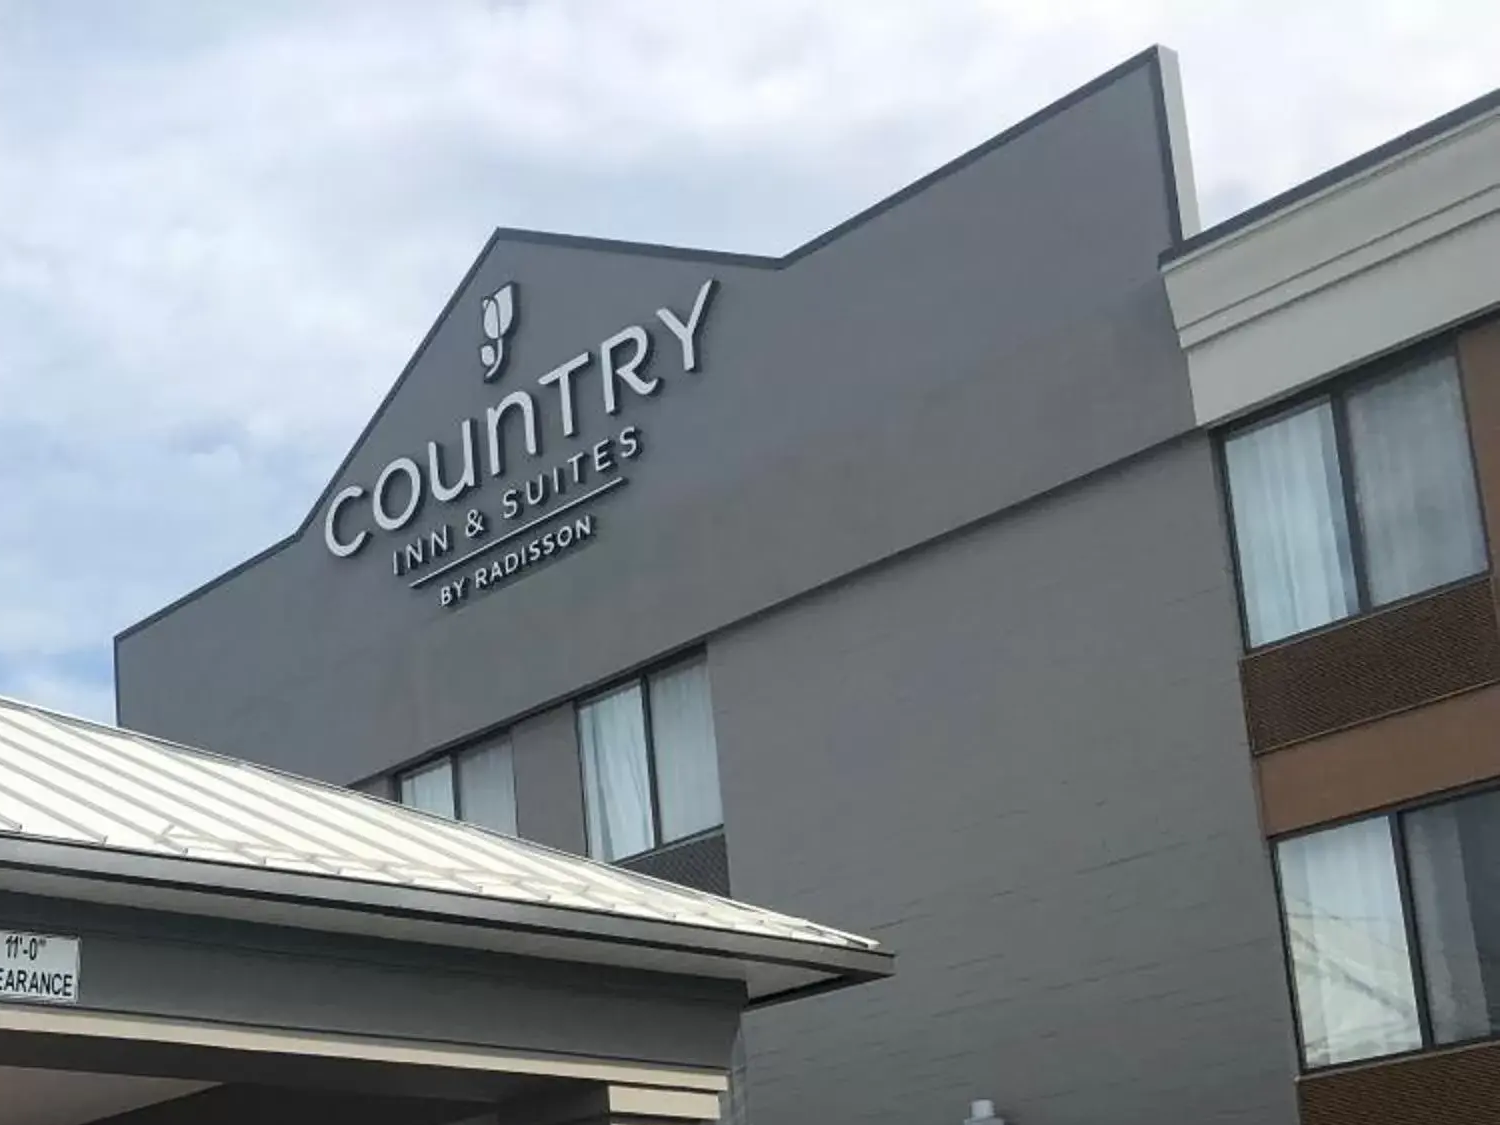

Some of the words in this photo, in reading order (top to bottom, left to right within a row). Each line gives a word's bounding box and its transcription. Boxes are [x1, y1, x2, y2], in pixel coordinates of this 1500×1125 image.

[392, 524, 451, 575] INN
[464, 508, 486, 537] &
[502, 426, 639, 520] SUITES
[440, 577, 466, 606] BY
[475, 514, 593, 588] RADISSON
